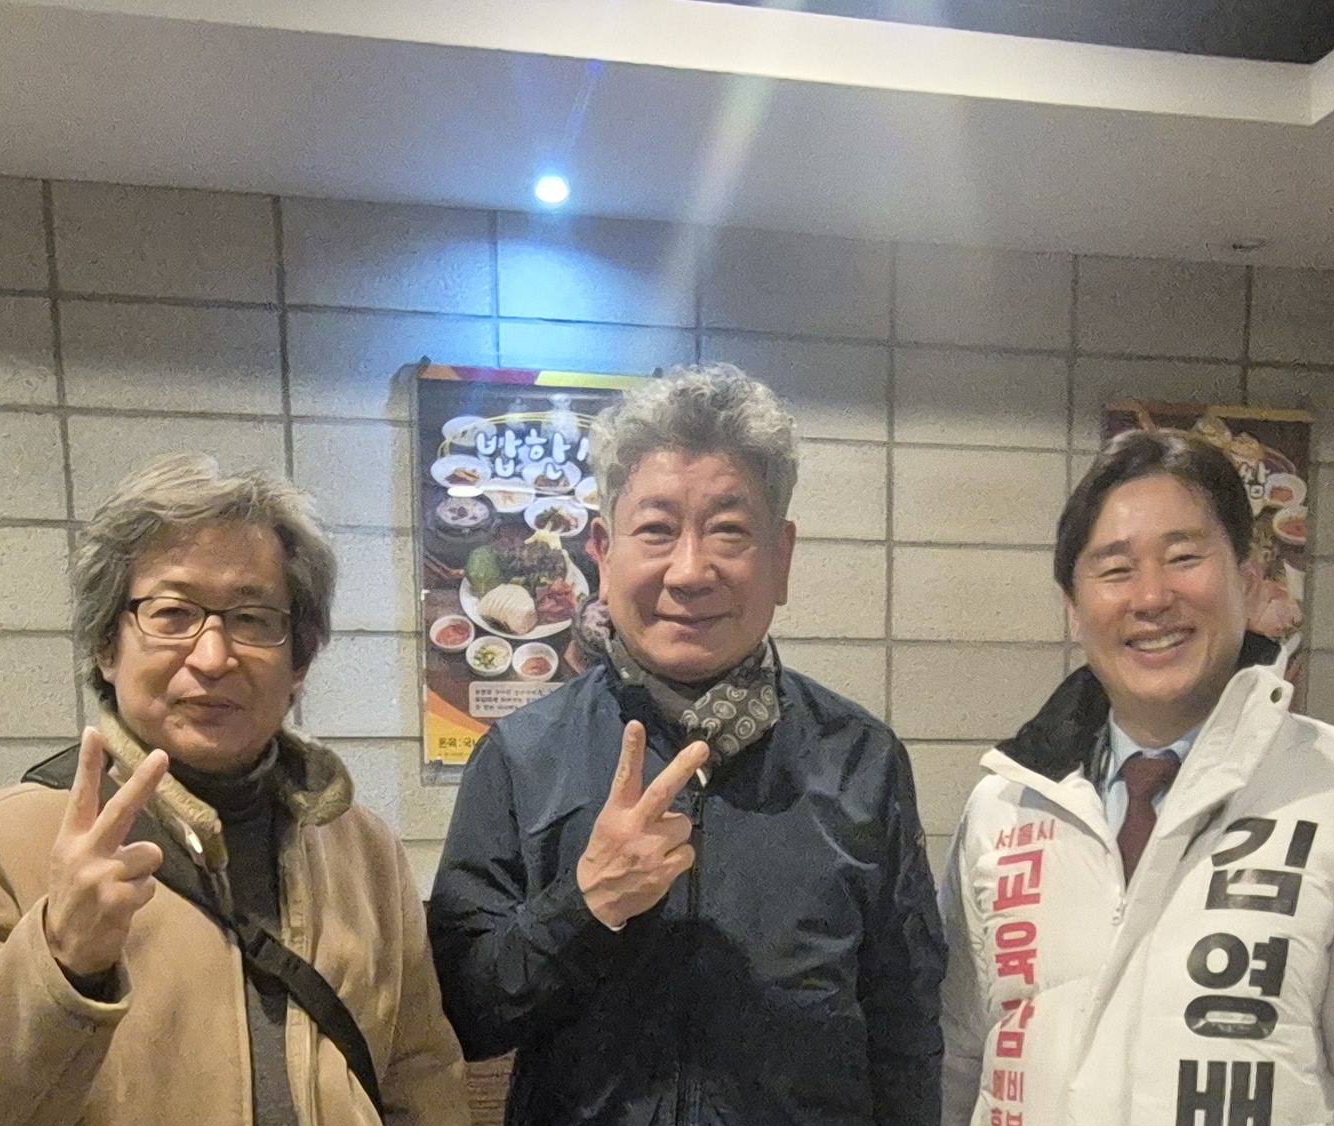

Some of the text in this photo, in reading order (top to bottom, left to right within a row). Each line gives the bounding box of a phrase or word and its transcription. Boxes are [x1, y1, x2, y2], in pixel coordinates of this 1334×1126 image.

[475, 428, 589, 481] 밥한
[994, 818, 1055, 850] 서울시
[992, 849, 1044, 1058] 교육감
